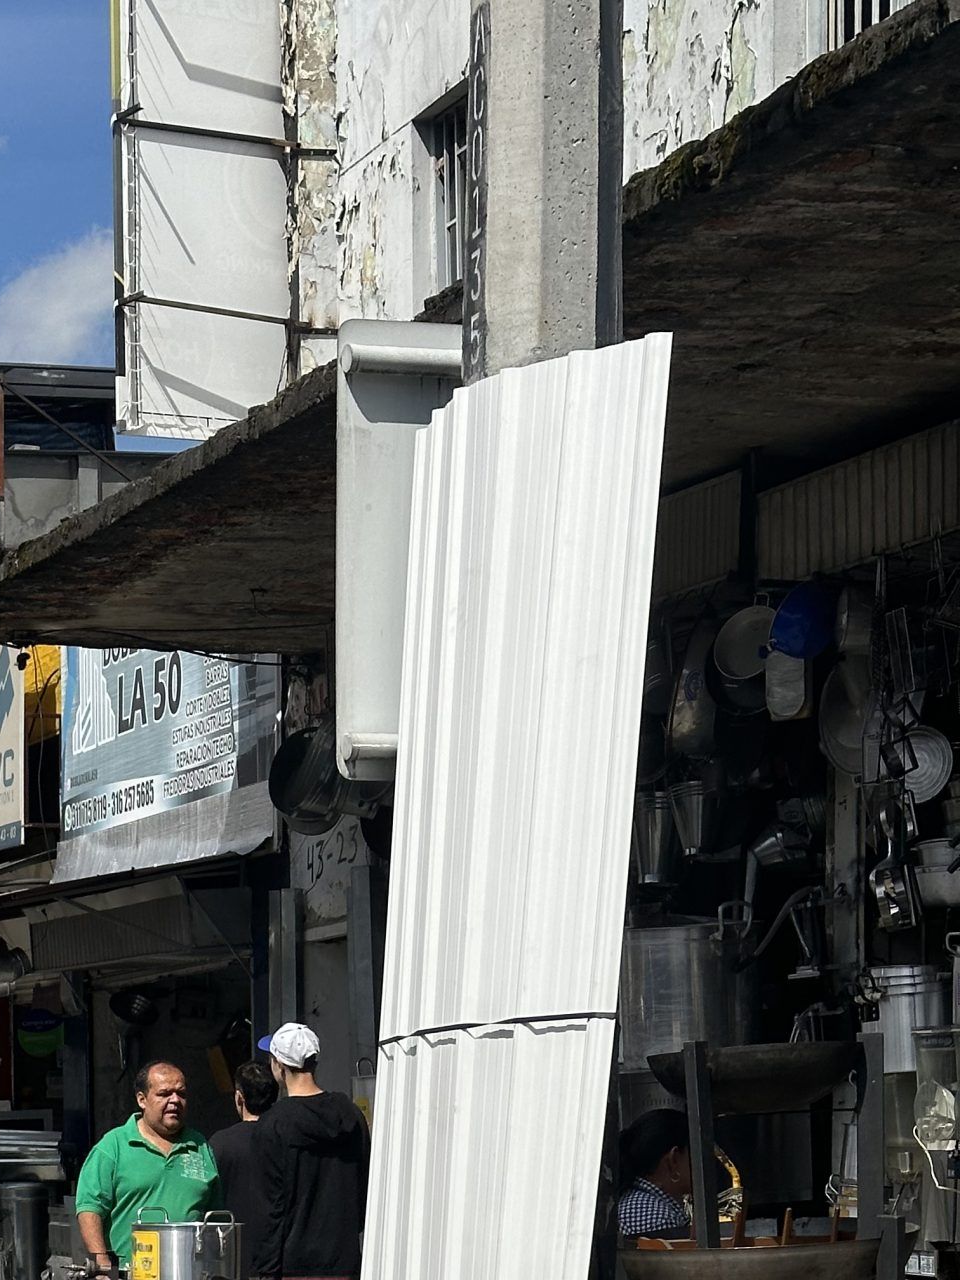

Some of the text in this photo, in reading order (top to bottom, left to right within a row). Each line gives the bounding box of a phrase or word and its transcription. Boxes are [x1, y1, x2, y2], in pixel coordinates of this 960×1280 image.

[118, 650, 183, 737] LA 50
[205, 662, 229, 688] BARRAS
[185, 693, 204, 717] CORTE
[208, 684, 230, 711] DOBLEZ
[171, 706, 232, 747] ESTUFAS INDUSTRIALES
[212, 732, 233, 760] TECHO
[163, 759, 235, 799] FREIDORAS INDUSTRIALES
[71, 801, 80, 829] 311
[92, 793, 107, 821] 8119
[111, 790, 123, 816] 316
[123, 785, 135, 812] 257
[136, 779, 154, 808] 5685
